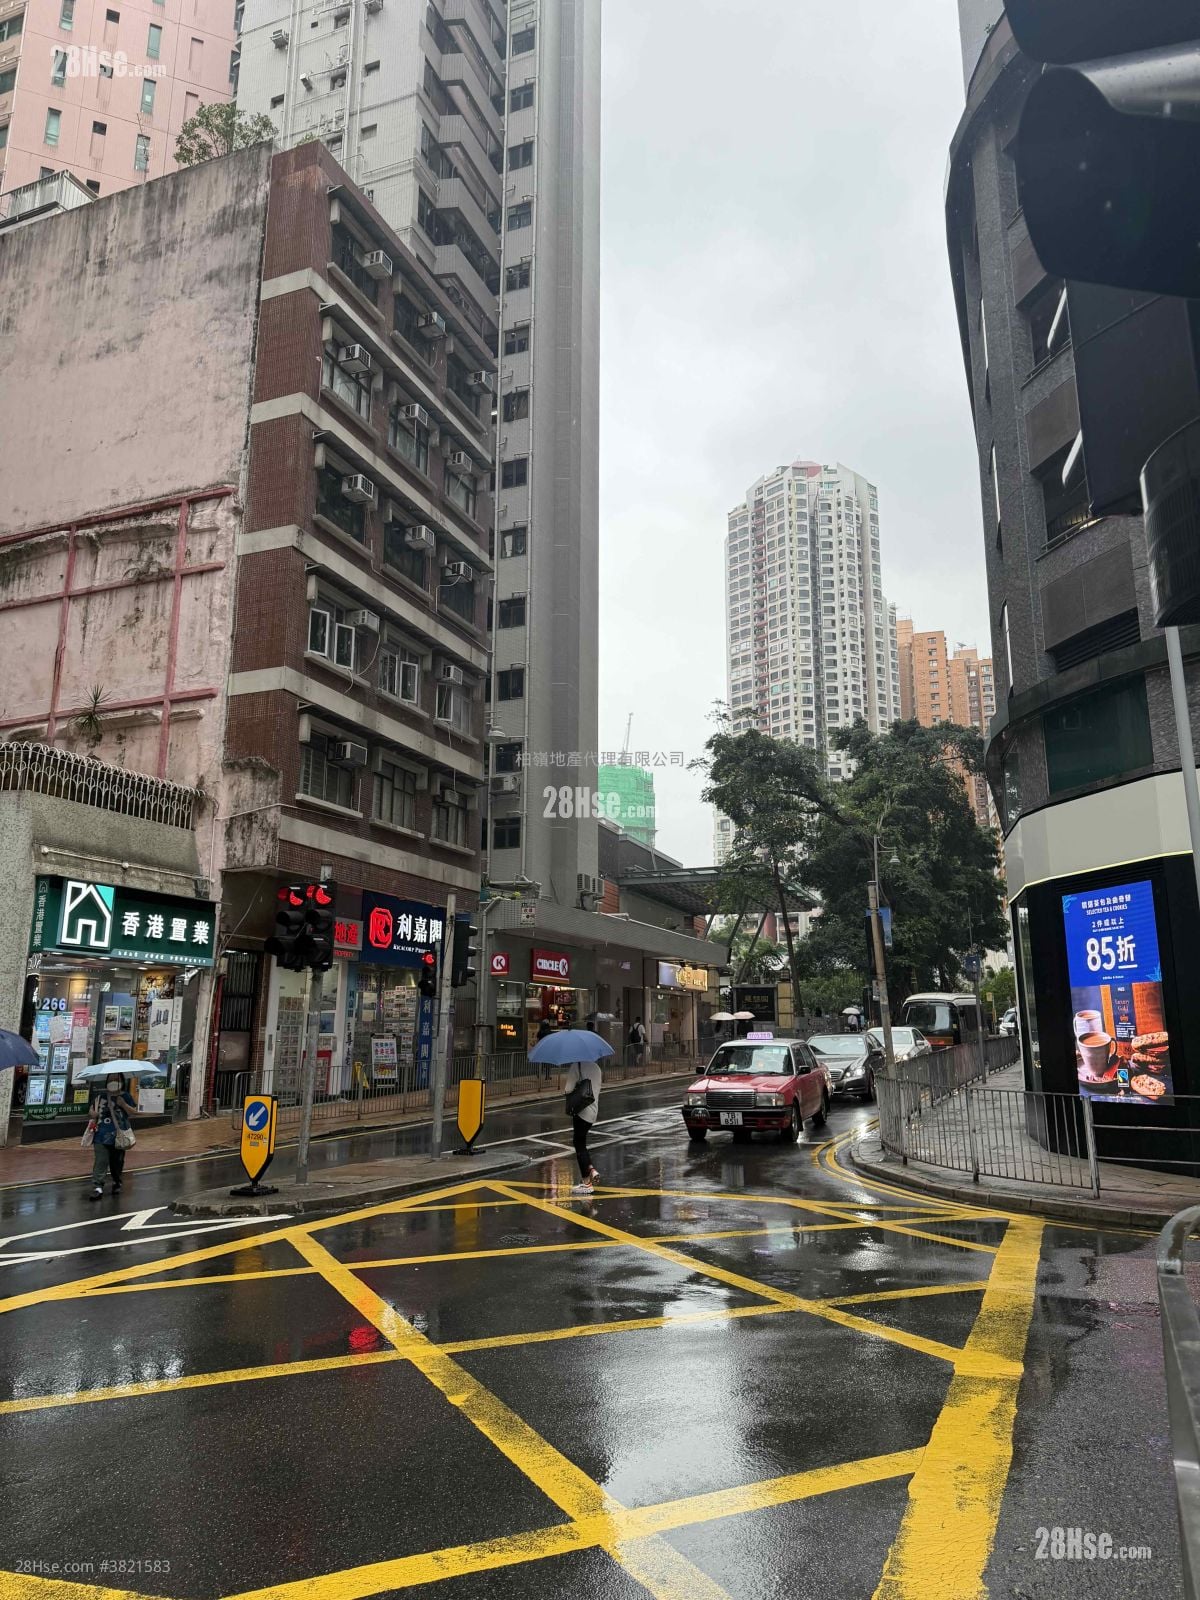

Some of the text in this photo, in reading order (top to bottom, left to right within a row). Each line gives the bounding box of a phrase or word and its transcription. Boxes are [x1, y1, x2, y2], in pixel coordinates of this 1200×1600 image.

[122, 911, 210, 945] 香港置業
[537, 958, 560, 971] CIRCLE
